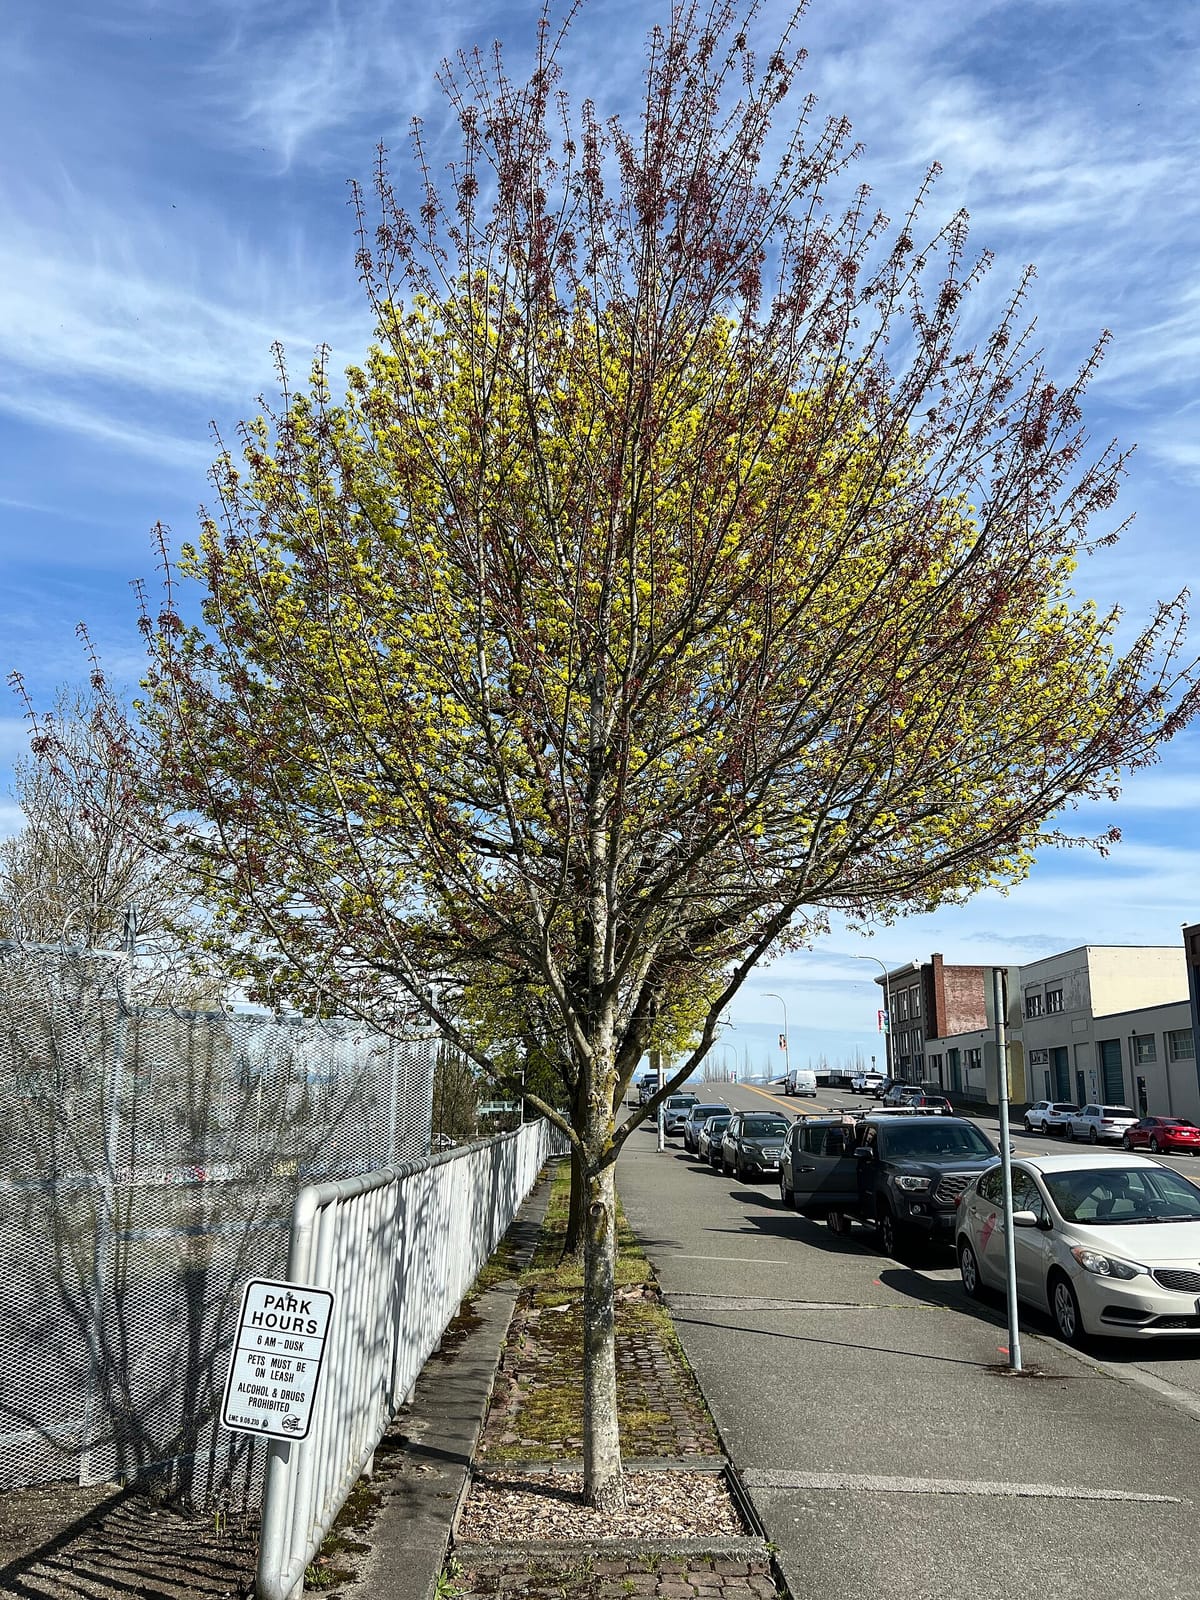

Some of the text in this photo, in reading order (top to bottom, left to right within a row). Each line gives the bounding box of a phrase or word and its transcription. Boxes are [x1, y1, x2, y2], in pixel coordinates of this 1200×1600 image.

[264, 1295, 312, 1315] PARK
[251, 1311, 318, 1334] HOURS
[257, 1335, 263, 1345] 6
[264, 1336, 277, 1348] AM
[284, 1339, 305, 1352] DUSK
[247, 1354, 307, 1373] PETS MUST BE
[255, 1367, 295, 1383] ON LEASH
[237, 1382, 306, 1403] ALCOHOL & DRUGS
[248, 1396, 290, 1413] PROHIBITED
